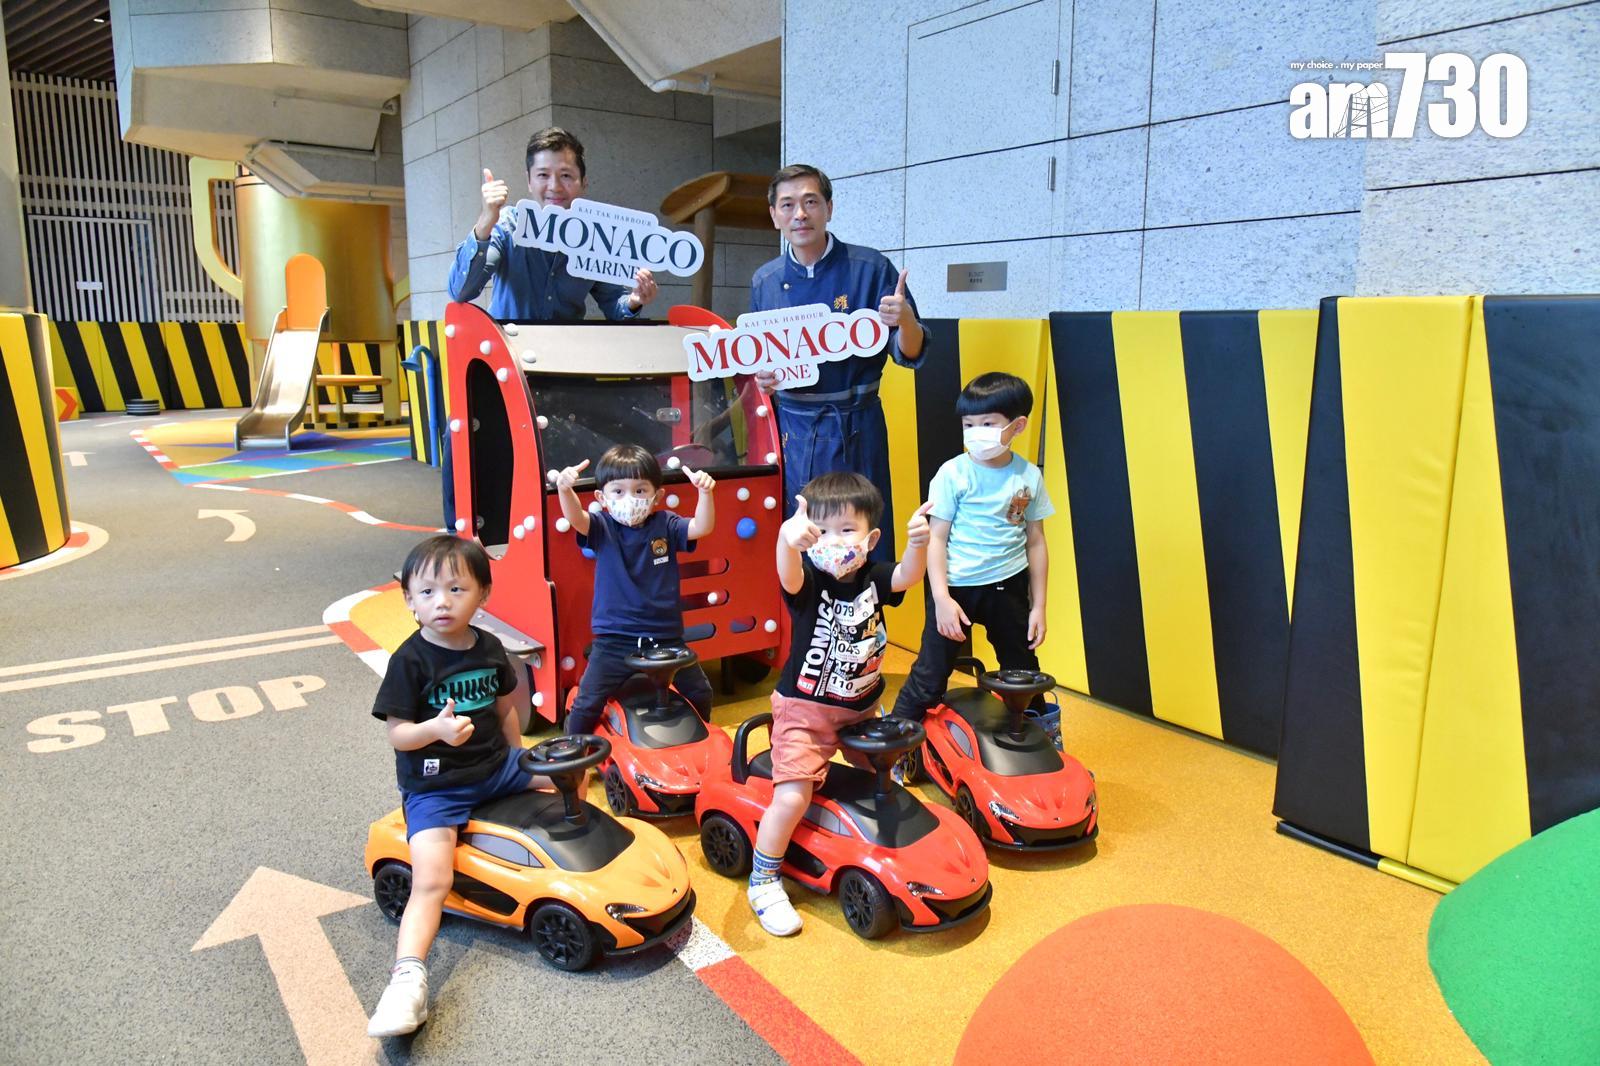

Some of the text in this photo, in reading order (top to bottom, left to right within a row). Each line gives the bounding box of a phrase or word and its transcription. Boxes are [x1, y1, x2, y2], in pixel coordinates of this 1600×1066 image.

[578, 207, 652, 227] KAI TAK HARBOUR
[522, 207, 698, 270] MONACO
[744, 311, 825, 328] KAI TAK HARBOUR
[692, 317, 882, 374] MONACO
[776, 363, 812, 382] ONE
[834, 603, 855, 617] 079
[837, 642, 860, 655] 045
[831, 676, 853, 691] 110
[26, 675, 327, 753] STOP
